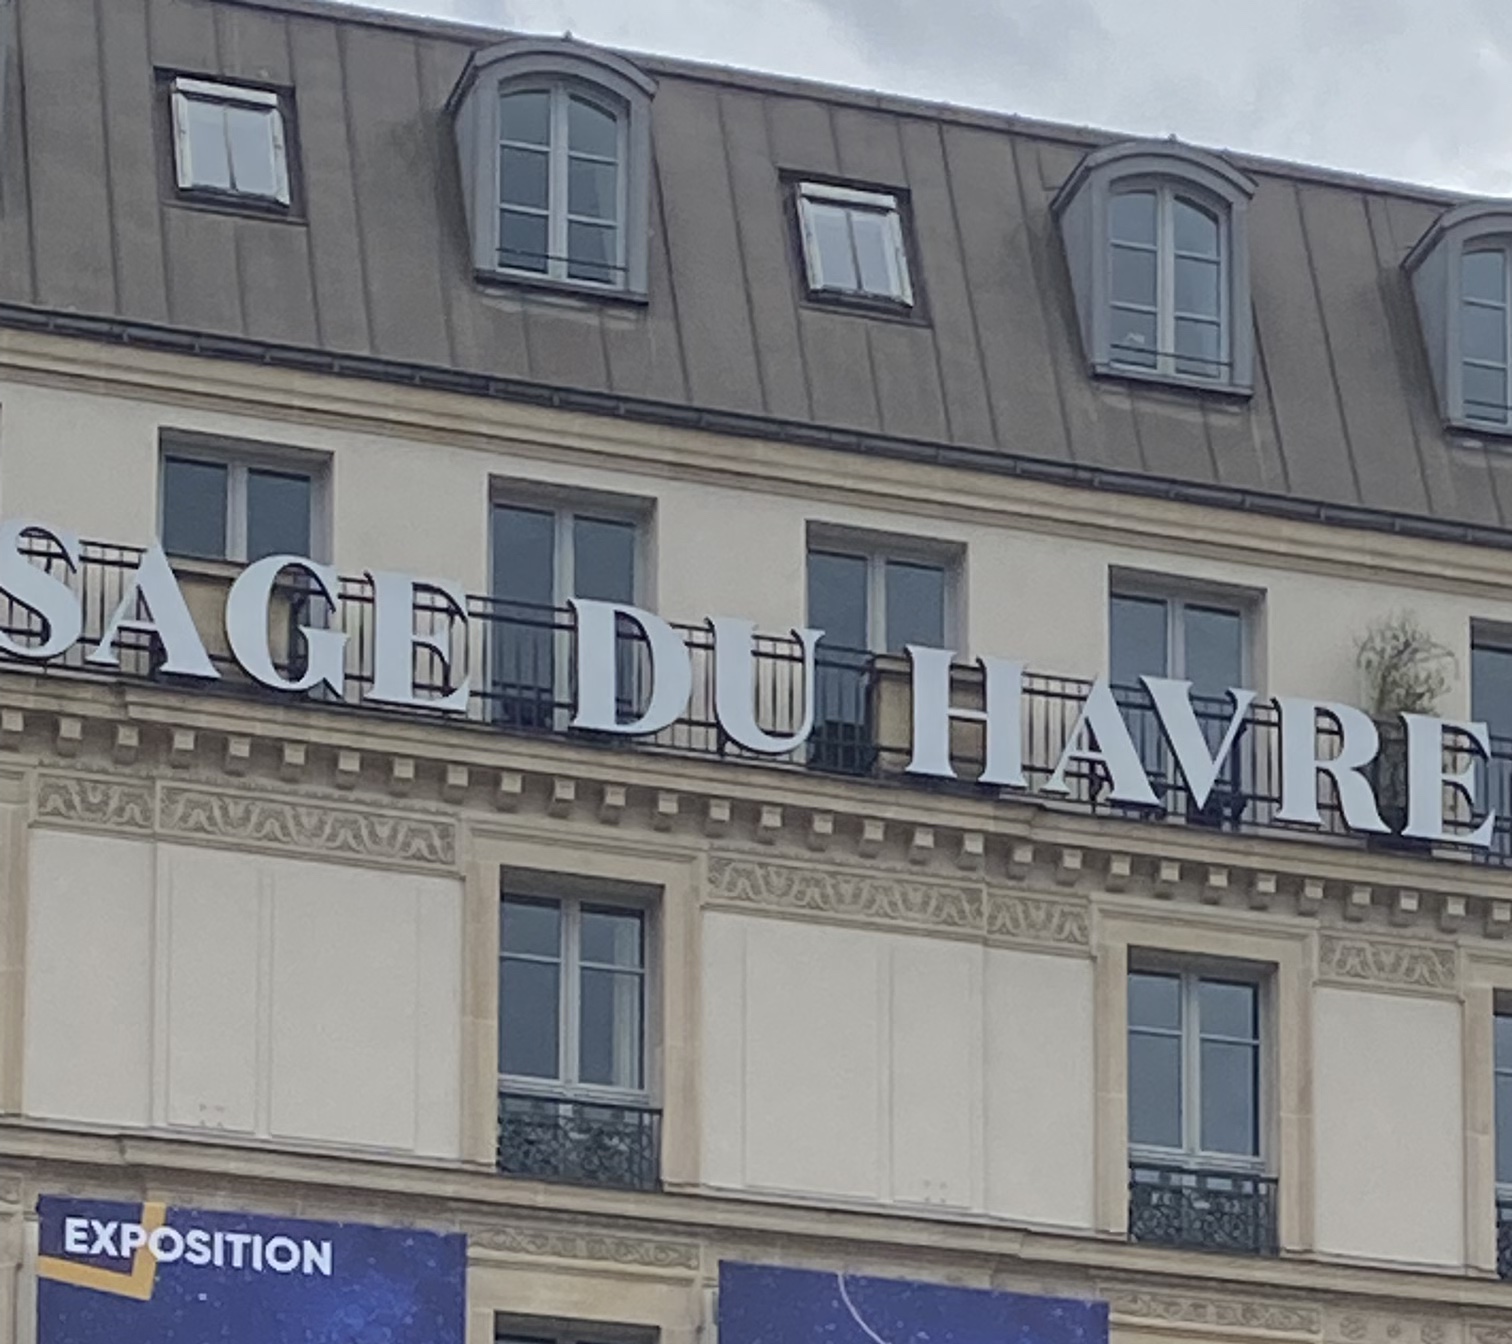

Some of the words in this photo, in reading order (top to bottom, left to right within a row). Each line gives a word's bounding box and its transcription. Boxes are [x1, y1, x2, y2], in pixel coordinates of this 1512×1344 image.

[569, 597, 826, 755] DU
[904, 643, 1495, 848] HAVRE
[64, 1216, 333, 1276] EXPOSITION
